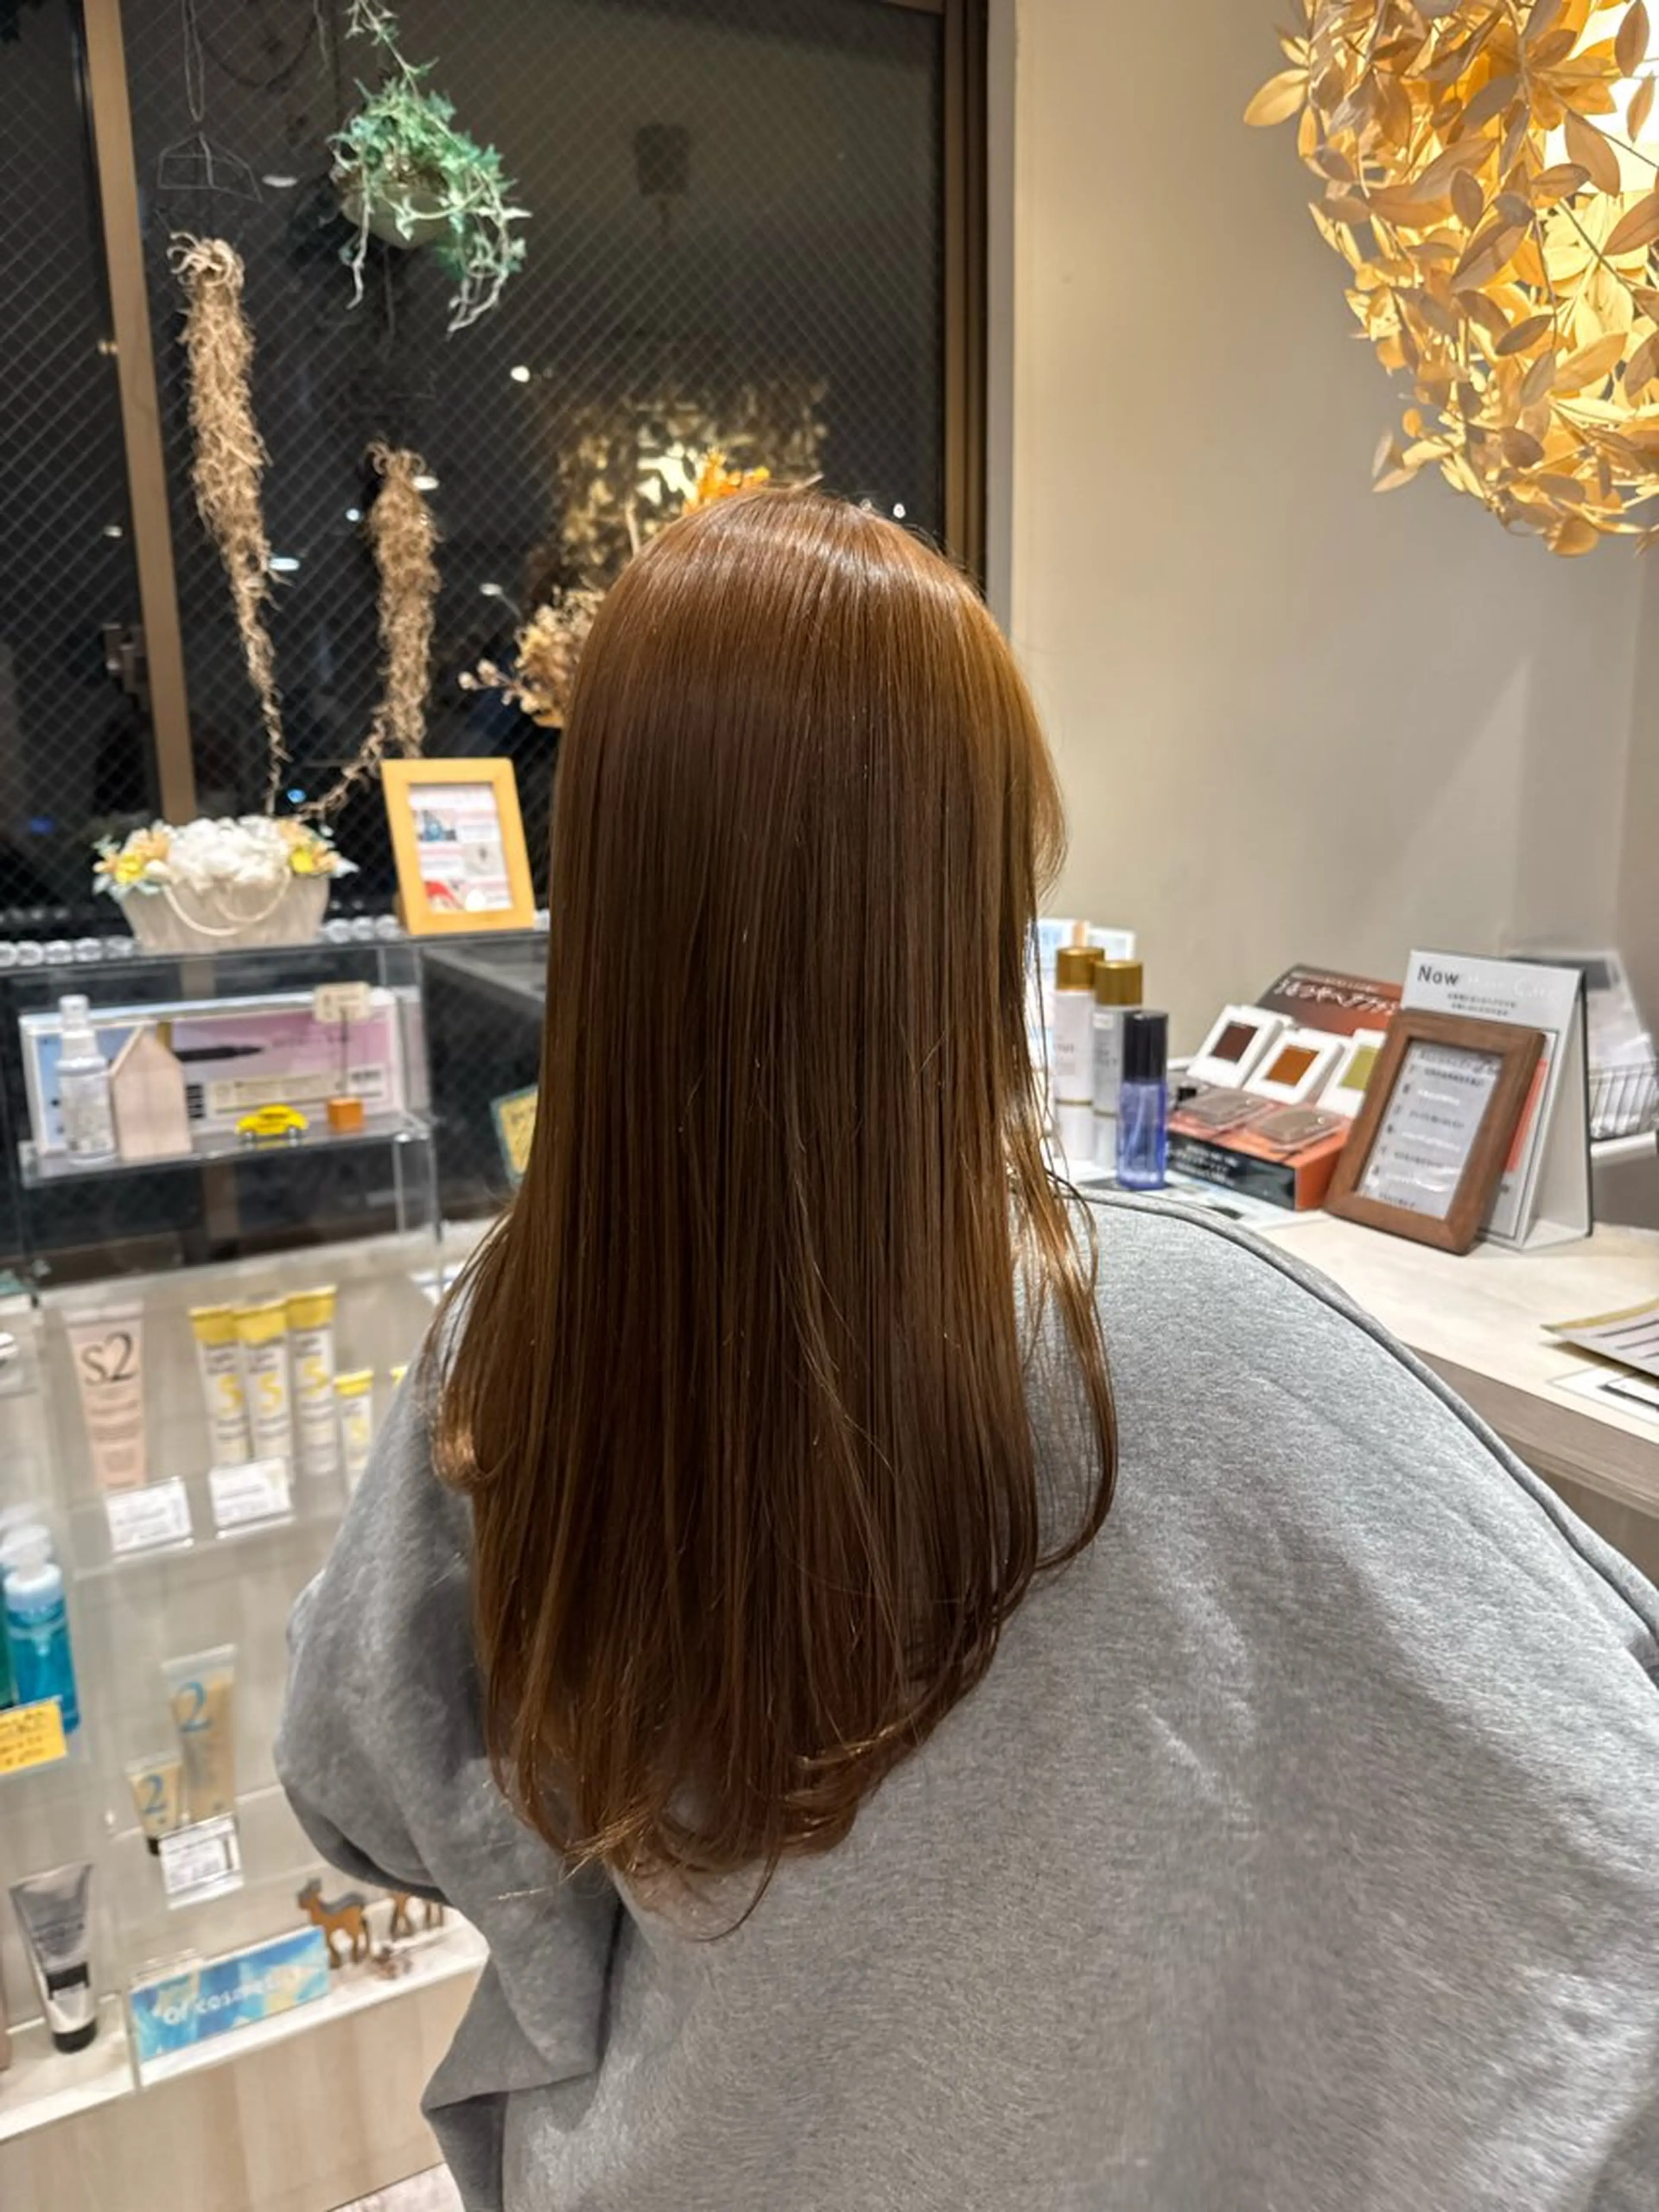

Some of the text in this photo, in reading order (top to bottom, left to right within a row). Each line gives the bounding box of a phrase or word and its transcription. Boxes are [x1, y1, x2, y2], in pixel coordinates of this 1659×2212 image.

[1417, 965, 1459, 988] Now
[178, 1681, 214, 1733] 2
[140, 1774, 167, 1815] 2
